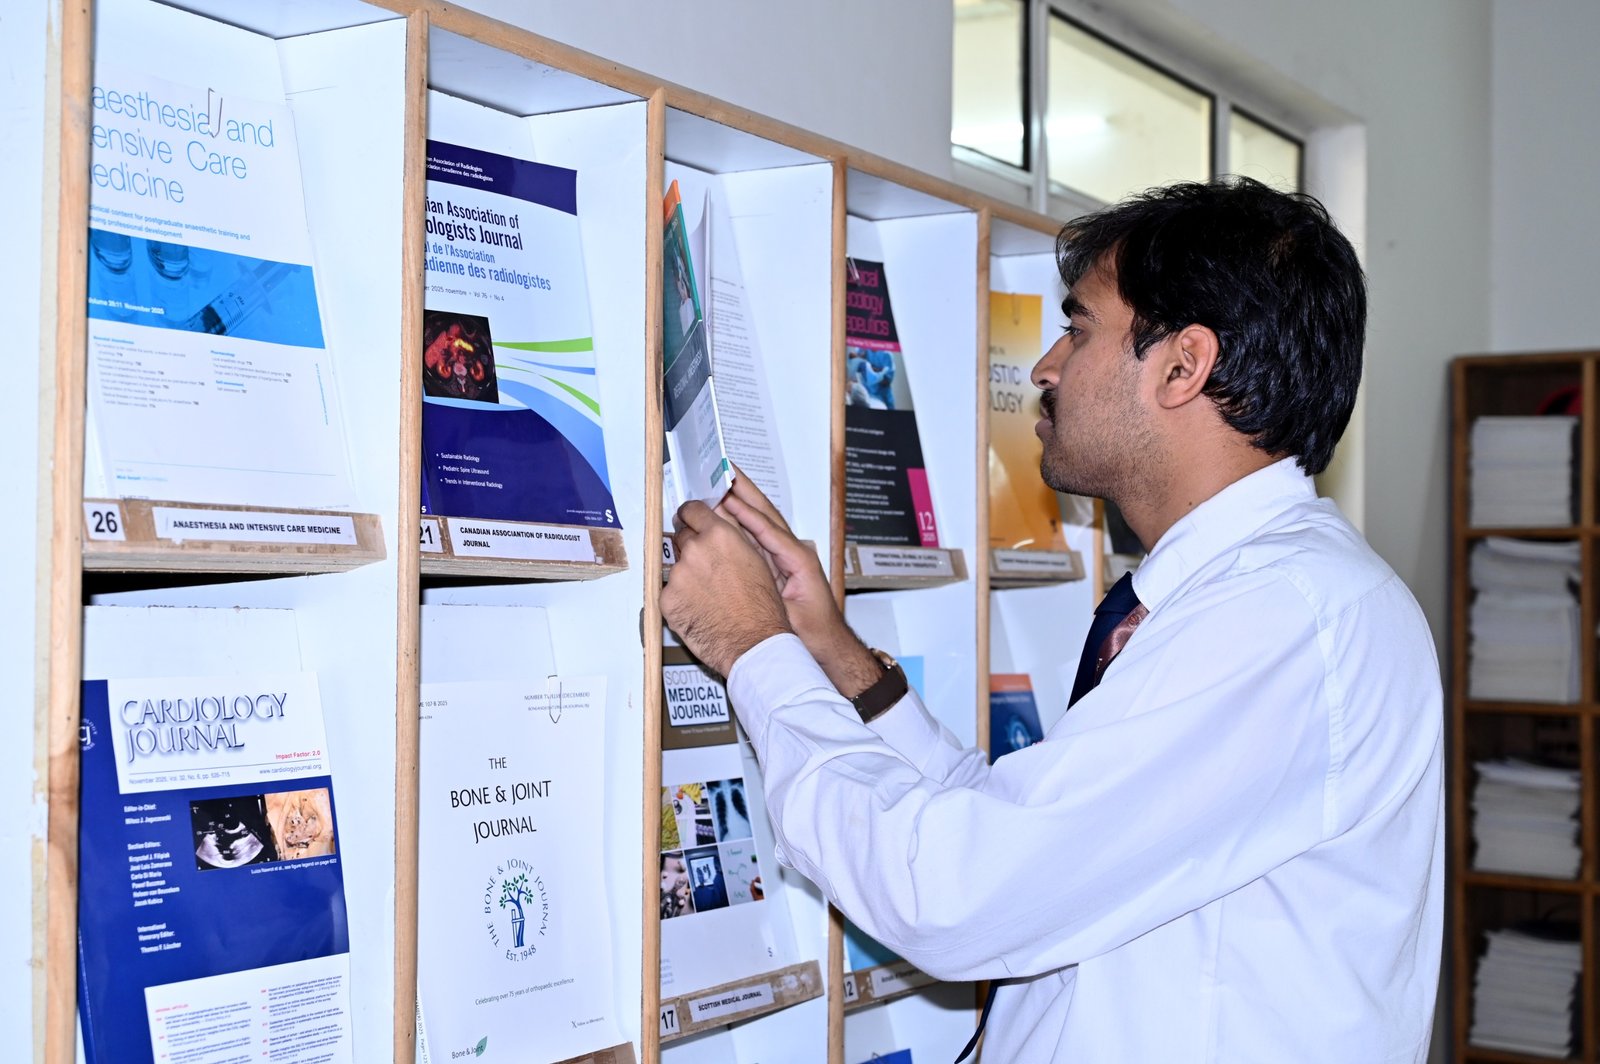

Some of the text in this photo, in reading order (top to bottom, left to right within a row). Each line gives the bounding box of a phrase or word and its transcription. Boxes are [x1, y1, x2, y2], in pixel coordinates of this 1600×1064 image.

[227, 120, 274, 147] and
[187, 140, 247, 180] Care
[111, 207, 251, 240] content for postgraduate anaesthetic training and
[447, 201, 507, 227] Association
[509, 214, 520, 229] of
[107, 219, 183, 239] professional development
[480, 225, 524, 251] Journal
[433, 242, 443, 255] de
[468, 263, 487, 280] des
[489, 268, 552, 291] radiologistes
[431, 285, 444, 293] 2025
[125, 303, 150, 313] November
[151, 307, 165, 315] 2025
[441, 453, 480, 463] Sustainable Radiology
[443, 465, 459, 473] Pediatric
[460, 467, 470, 475] Spine
[463, 479, 485, 487] Interventional
[486, 481, 503, 489] Radiology
[92, 510, 118, 534] 26
[173, 520, 341, 535] ANAESTHESIA AND INTENSIVE CARE MEDICINE
[919, 512, 935, 530] 12
[460, 527, 490, 535] CANADIAN
[544, 533, 580, 541] RADIOLOGIST
[463, 540, 490, 548] JOURNAL
[668, 686, 723, 702] MEDICAL
[121, 693, 287, 727] CARDIOLOGY
[672, 703, 726, 720] JOURNAL
[127, 723, 245, 763] JOURNAL
[275, 752, 292, 760] Impact
[293, 751, 311, 759] Factor:
[488, 757, 507, 770] THE
[259, 763, 322, 775] www.cardiologyjournal.org
[129, 776, 154, 785] November
[450, 780, 552, 808] BONE & JOINT
[473, 816, 537, 844] JOURNAL
[484, 858, 549, 948] THE BONE & JOINT JOURNAL
[520, 944, 537, 961] 1948
[475, 994, 500, 1006] Celebrating
[500, 993, 509, 1001] over
[514, 988, 525, 999] years
[530, 982, 553, 994] orthopaedic
[553, 977, 575, 988] excellence
[698, 991, 762, 1011] SCOTTISH MEDICAL JOURNAL
[661, 1010, 674, 1029] 17
[451, 1049, 466, 1060] Bone
[466, 1047, 471, 1057] &
